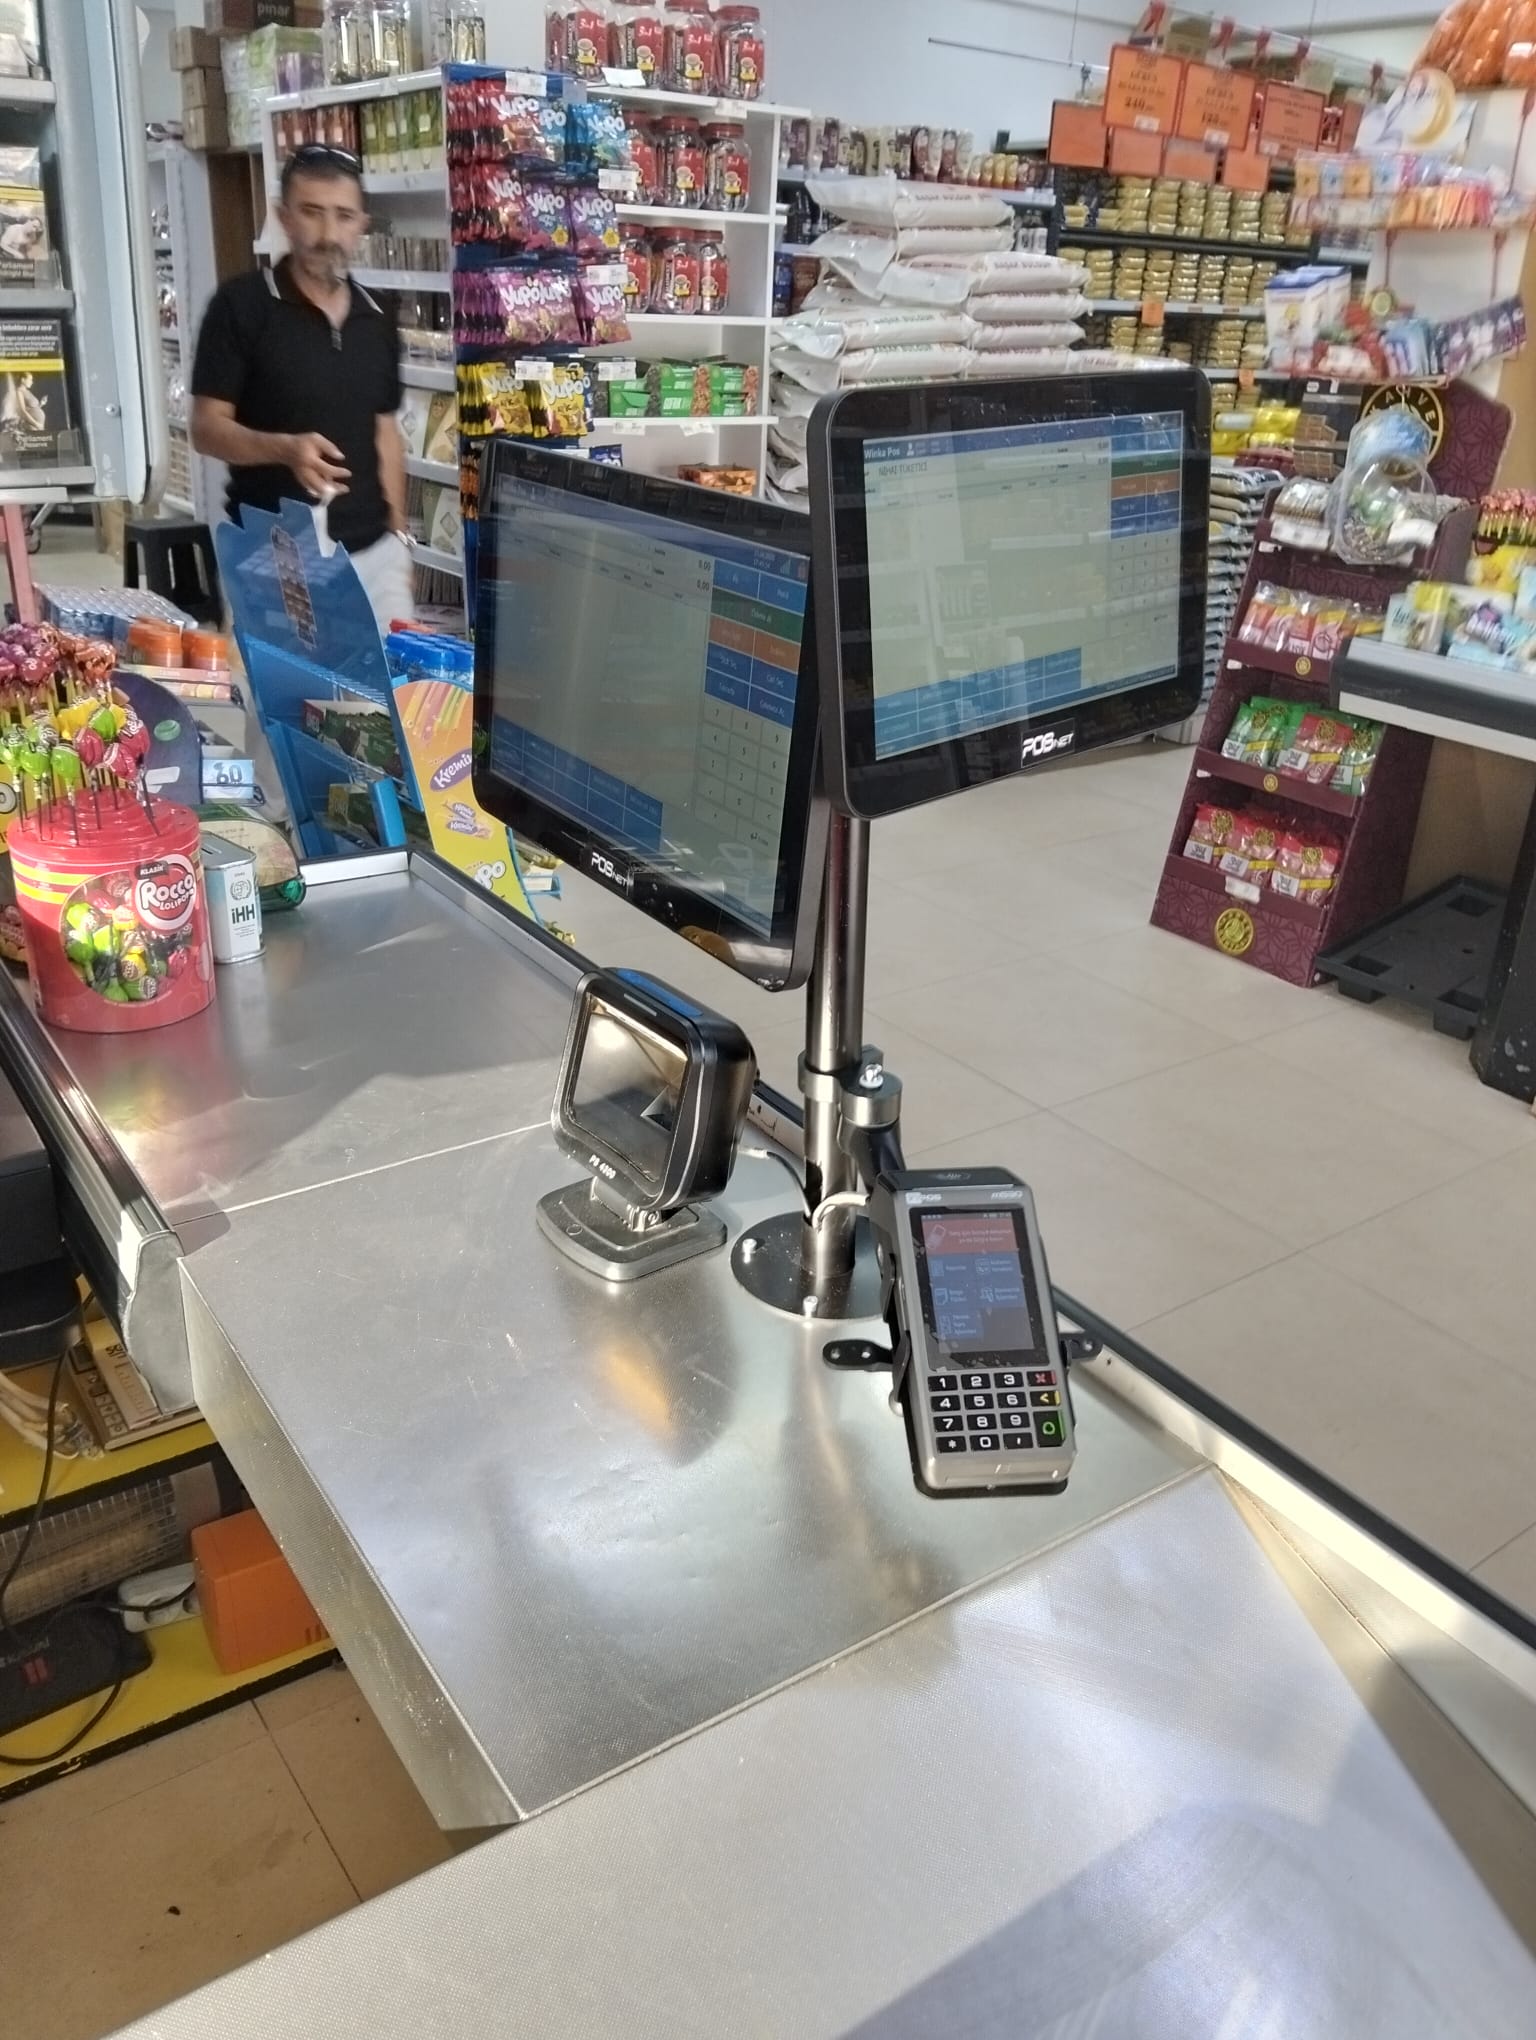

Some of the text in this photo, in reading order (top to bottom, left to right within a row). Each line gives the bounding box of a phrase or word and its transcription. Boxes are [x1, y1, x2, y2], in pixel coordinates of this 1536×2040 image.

[939, 1377, 946, 1388] 1
[970, 1376, 982, 1387] 2
[1003, 1374, 1015, 1385] 3
[940, 1398, 951, 1408] 4
[973, 1395, 986, 1407] 5
[1006, 1394, 1018, 1405] 6
[942, 1418, 954, 1429] 7
[976, 1416, 988, 1427] 8
[1009, 1414, 1022, 1426] 9
[980, 1436, 992, 1448] 0
